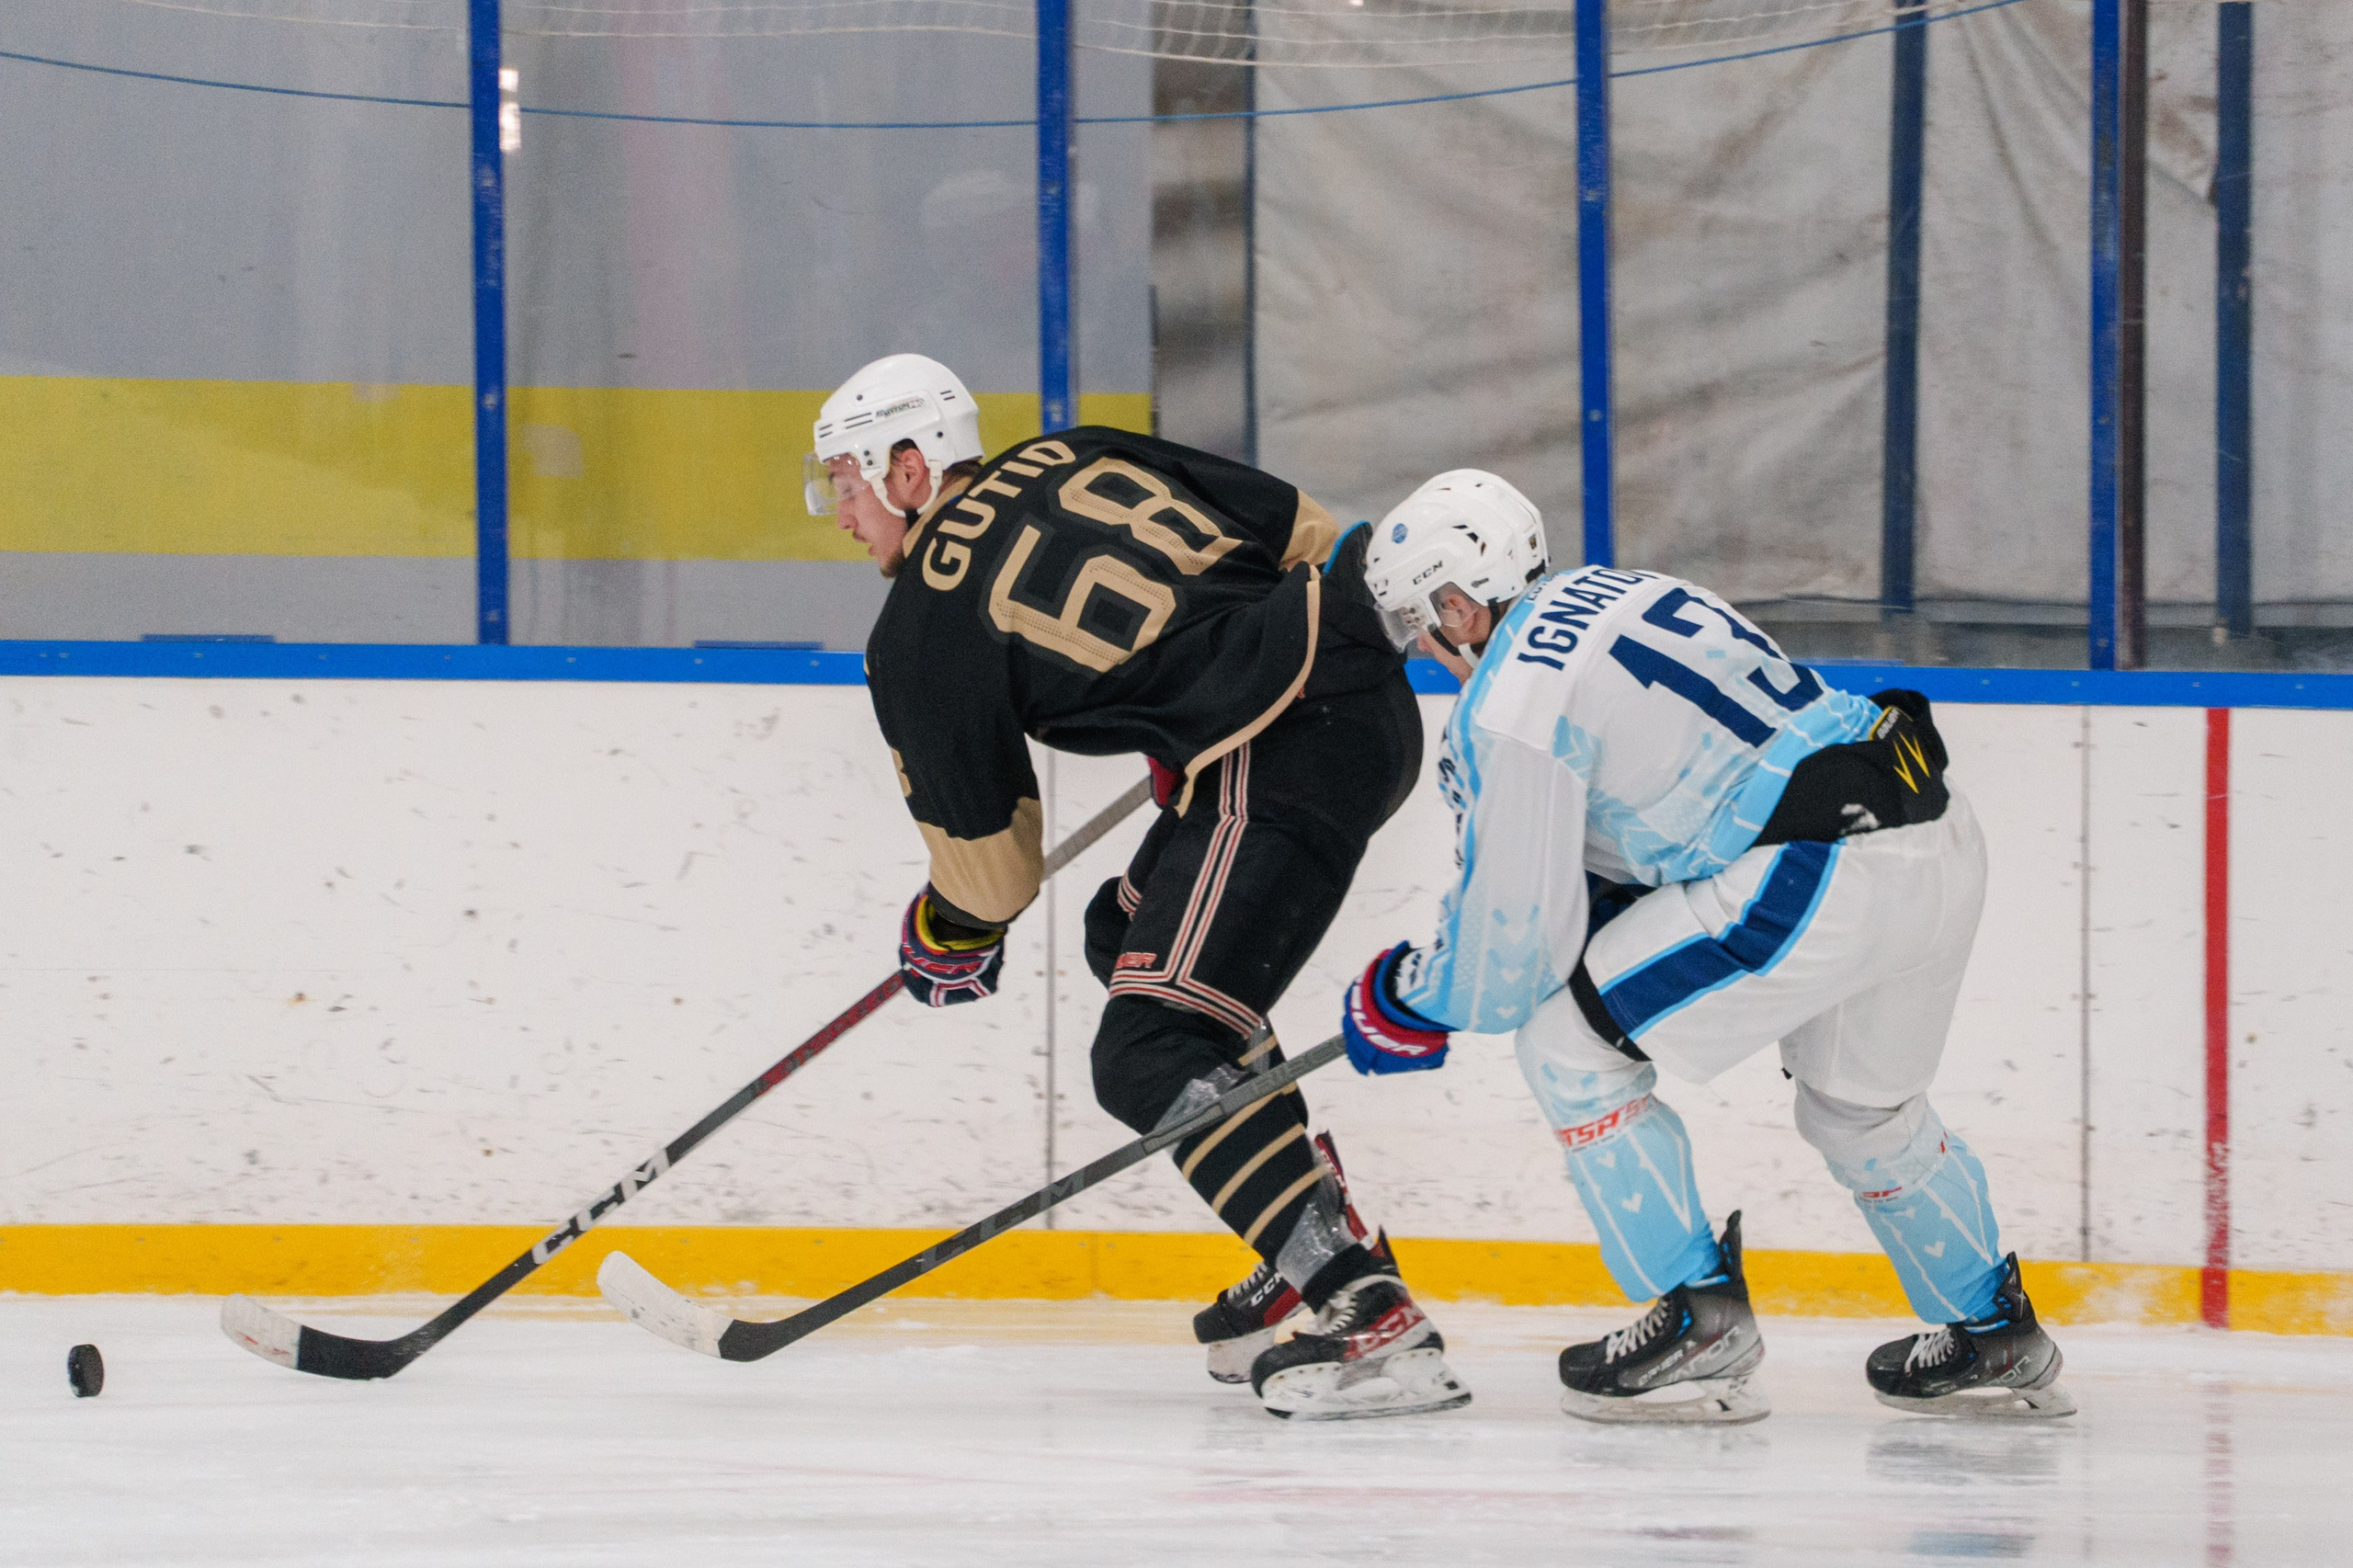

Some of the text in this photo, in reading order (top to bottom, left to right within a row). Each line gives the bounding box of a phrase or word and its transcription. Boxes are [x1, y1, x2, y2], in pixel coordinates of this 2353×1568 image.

[922, 440, 1076, 591] GUTID
[988, 456, 1243, 673] 68
[1413, 560, 1444, 585] CCM
[1608, 586, 1824, 749] 13
[531, 1146, 671, 1266] CCM
